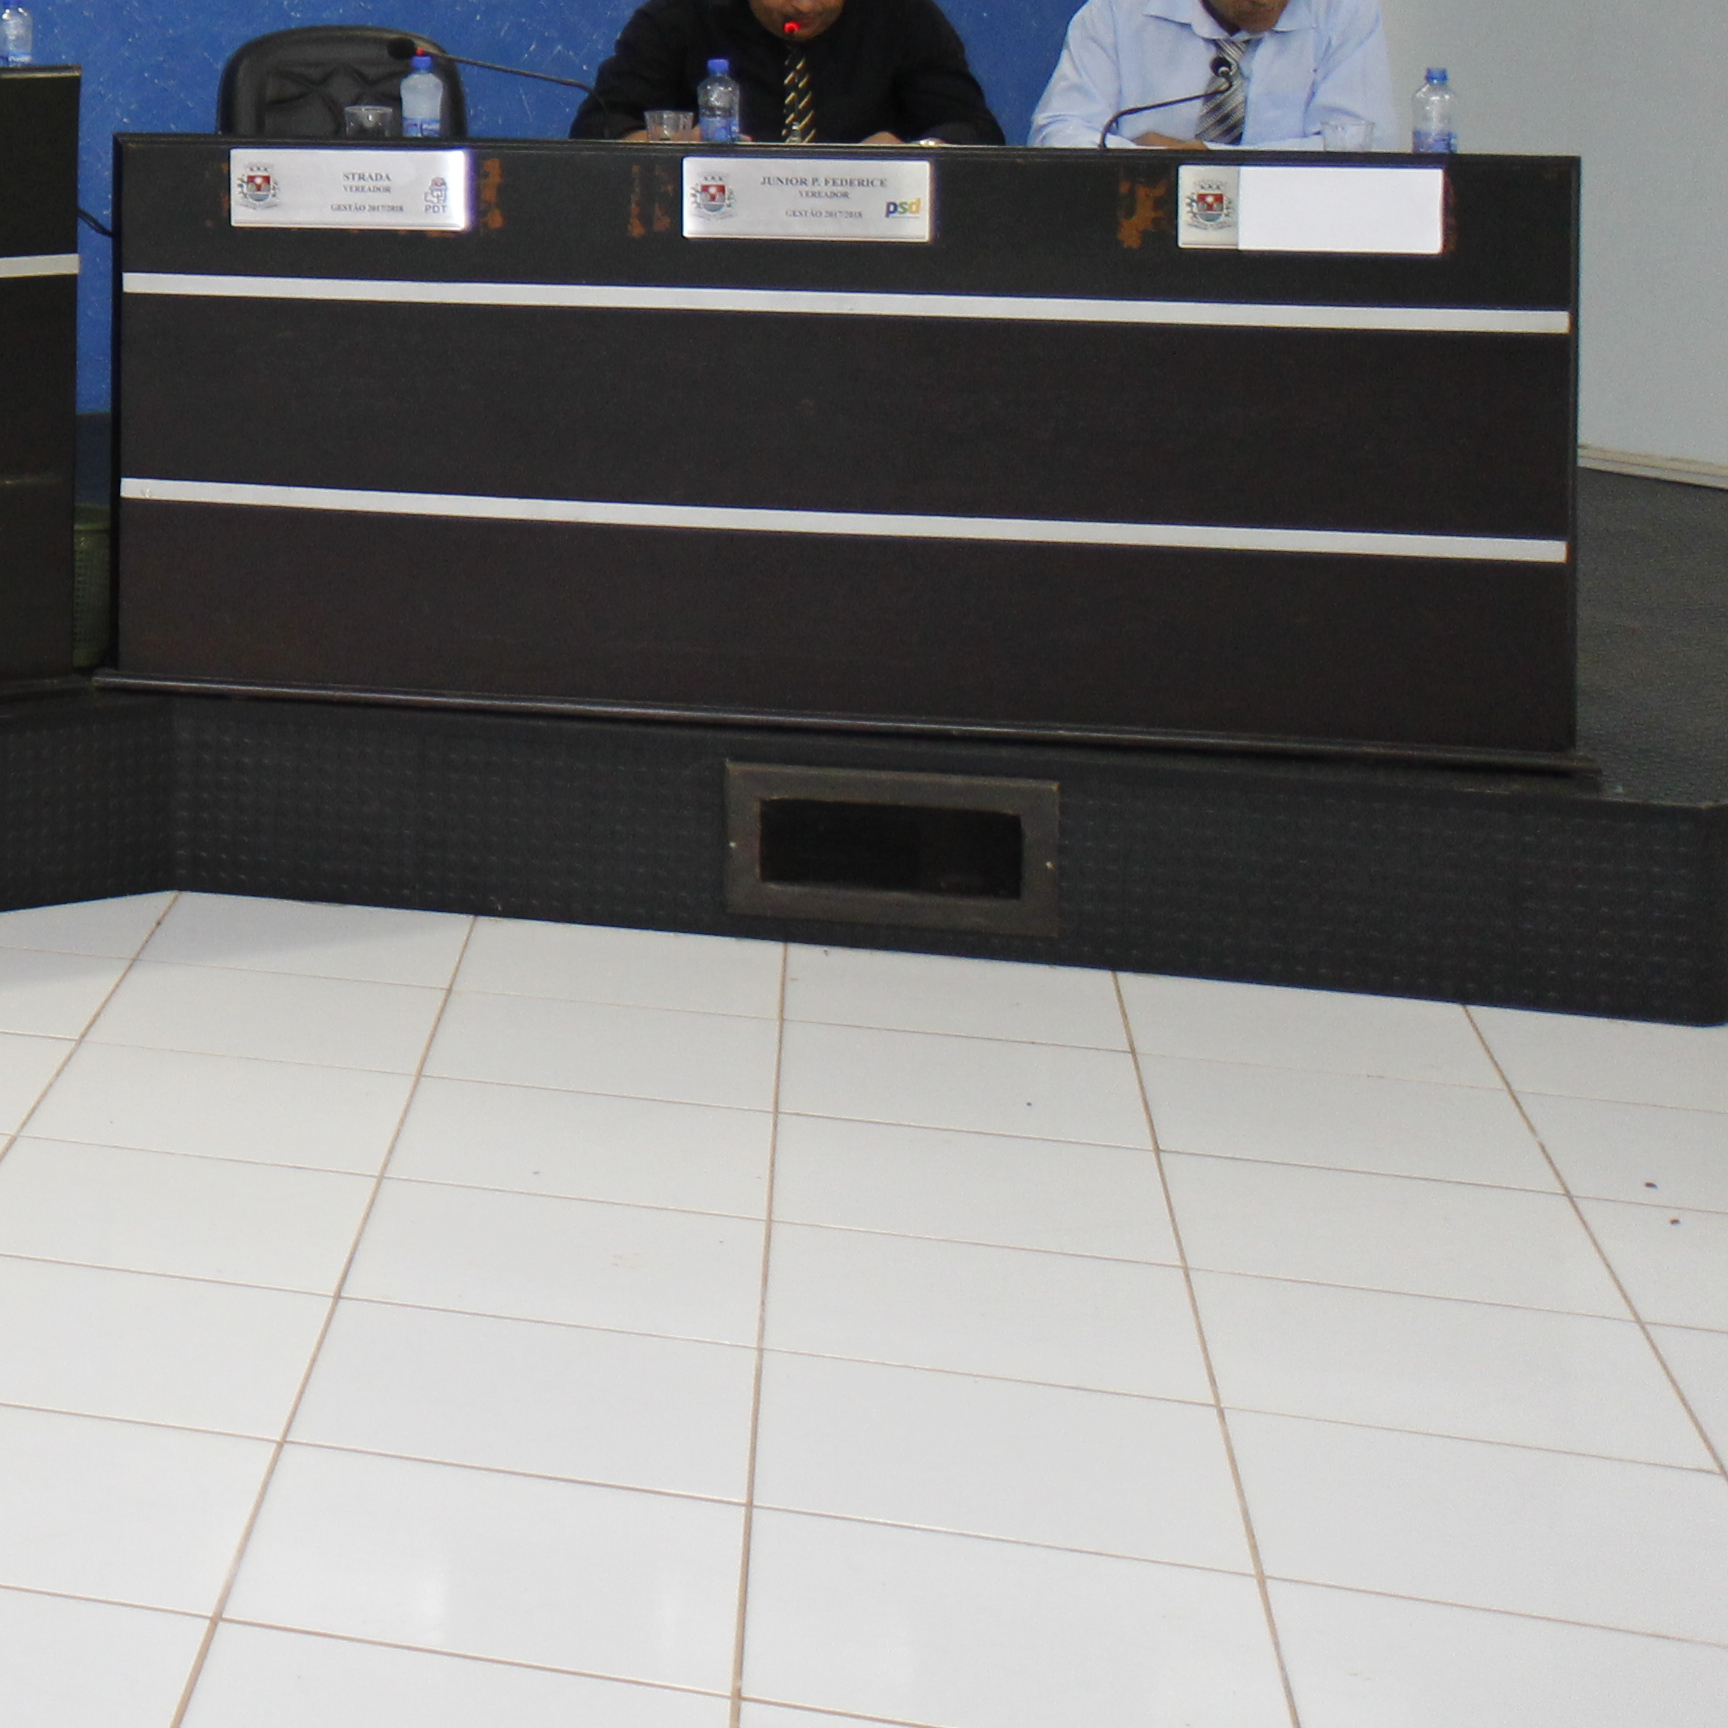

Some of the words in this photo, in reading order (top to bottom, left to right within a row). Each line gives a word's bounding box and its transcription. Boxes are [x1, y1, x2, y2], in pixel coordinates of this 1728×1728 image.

[343, 172, 392, 183] STRADA
[760, 175, 809, 187] JUNIOR
[823, 176, 888, 188] FEDERICE
[343, 184, 392, 194] VEREADOR
[798, 190, 850, 199] VEREADOR
[330, 202, 366, 213] GESTÃO
[424, 204, 447, 214] PDT
[785, 207, 822, 219] GESTÃO
[884, 197, 923, 219] psd
